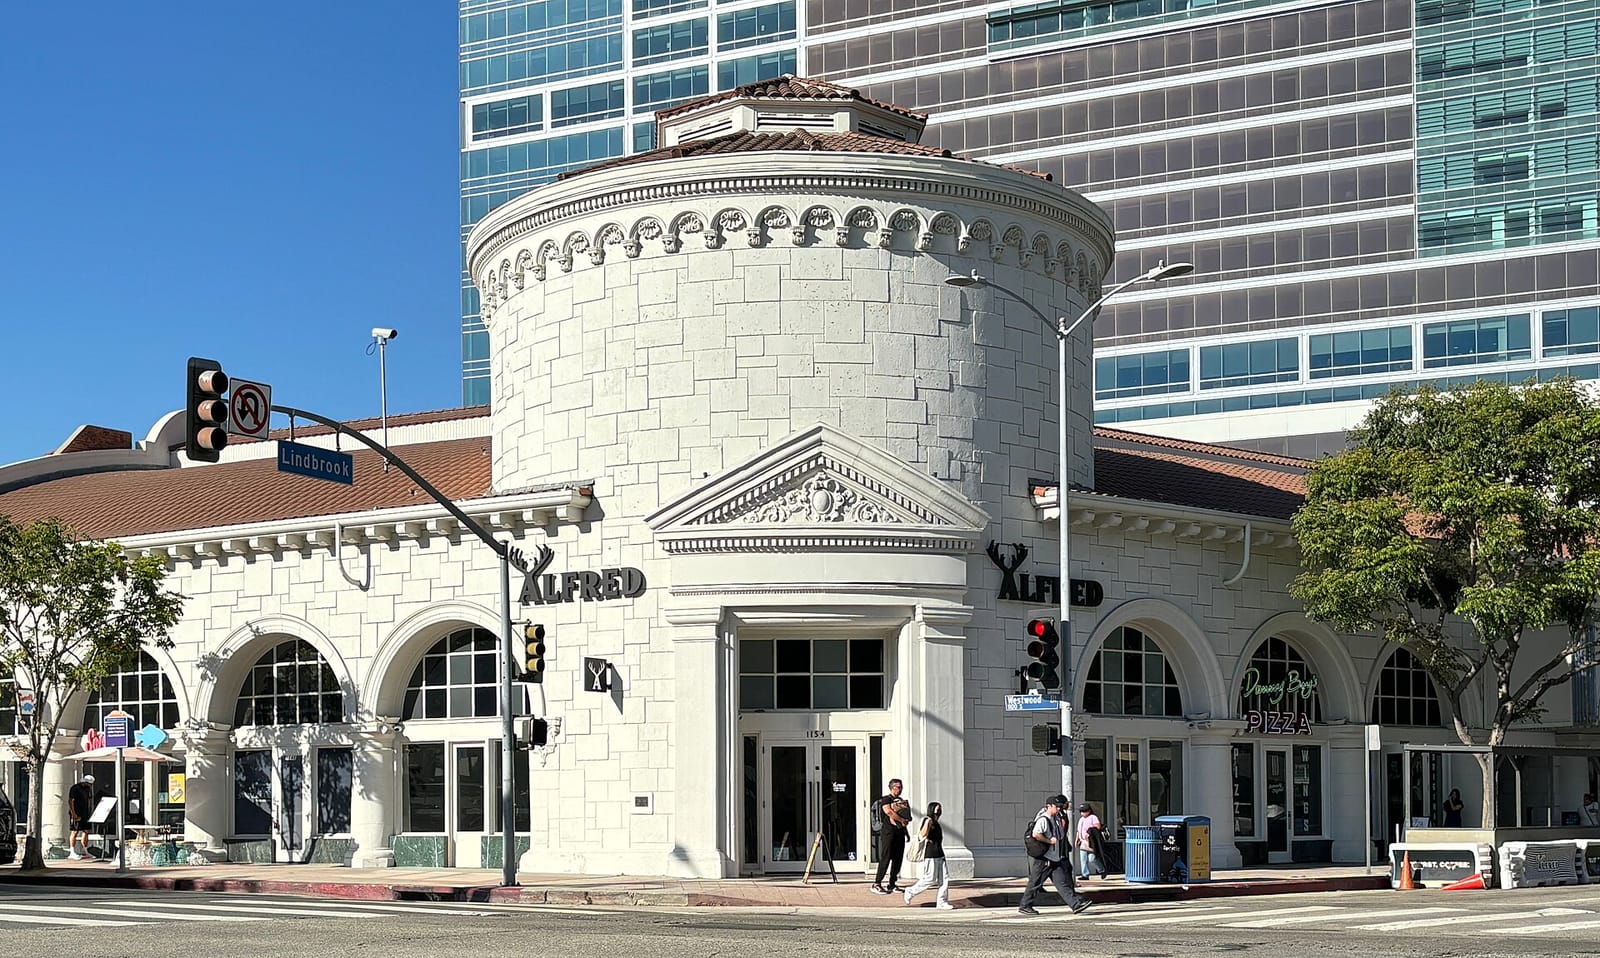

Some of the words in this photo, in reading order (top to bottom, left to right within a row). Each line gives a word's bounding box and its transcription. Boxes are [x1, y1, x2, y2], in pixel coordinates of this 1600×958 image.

[281, 447, 349, 477] Lindbrook
[516, 558, 647, 606] ALFRED
[1007, 695, 1042, 704] Westwood
[1243, 667, 1285, 704] Danny
[1286, 670, 1319, 699] Boy's
[806, 730, 825, 738] 1154
[1247, 709, 1312, 735] PIZZA
[1301, 748, 1309, 832] WINGS
